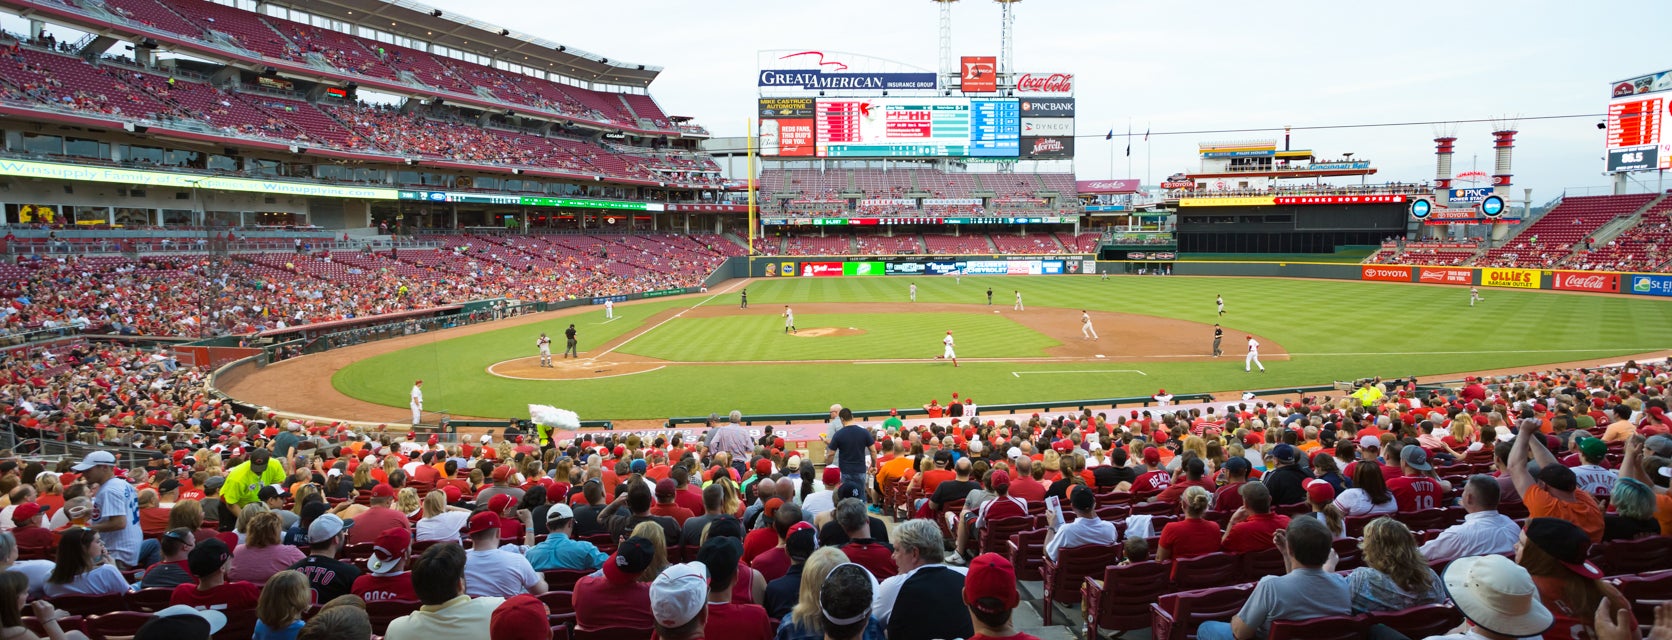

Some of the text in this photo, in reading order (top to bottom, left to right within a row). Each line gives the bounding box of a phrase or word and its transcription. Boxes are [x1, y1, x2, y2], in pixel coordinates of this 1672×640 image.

[762, 71, 884, 88] GREAT AMERICAN
[1031, 102, 1074, 111] PNC BANK
[1309, 161, 1369, 171] Cincinnati Bell
[0, 161, 97, 179] Winsupply
[104, 170, 150, 184] Family
[157, 175, 170, 183] of
[1465, 188, 1486, 197] PNC
[1376, 269, 1409, 278] TOYOTA
[1650, 280, 1662, 289] St
[1410, 480, 1434, 492] VOTTO
[297, 567, 336, 586] OTTO
